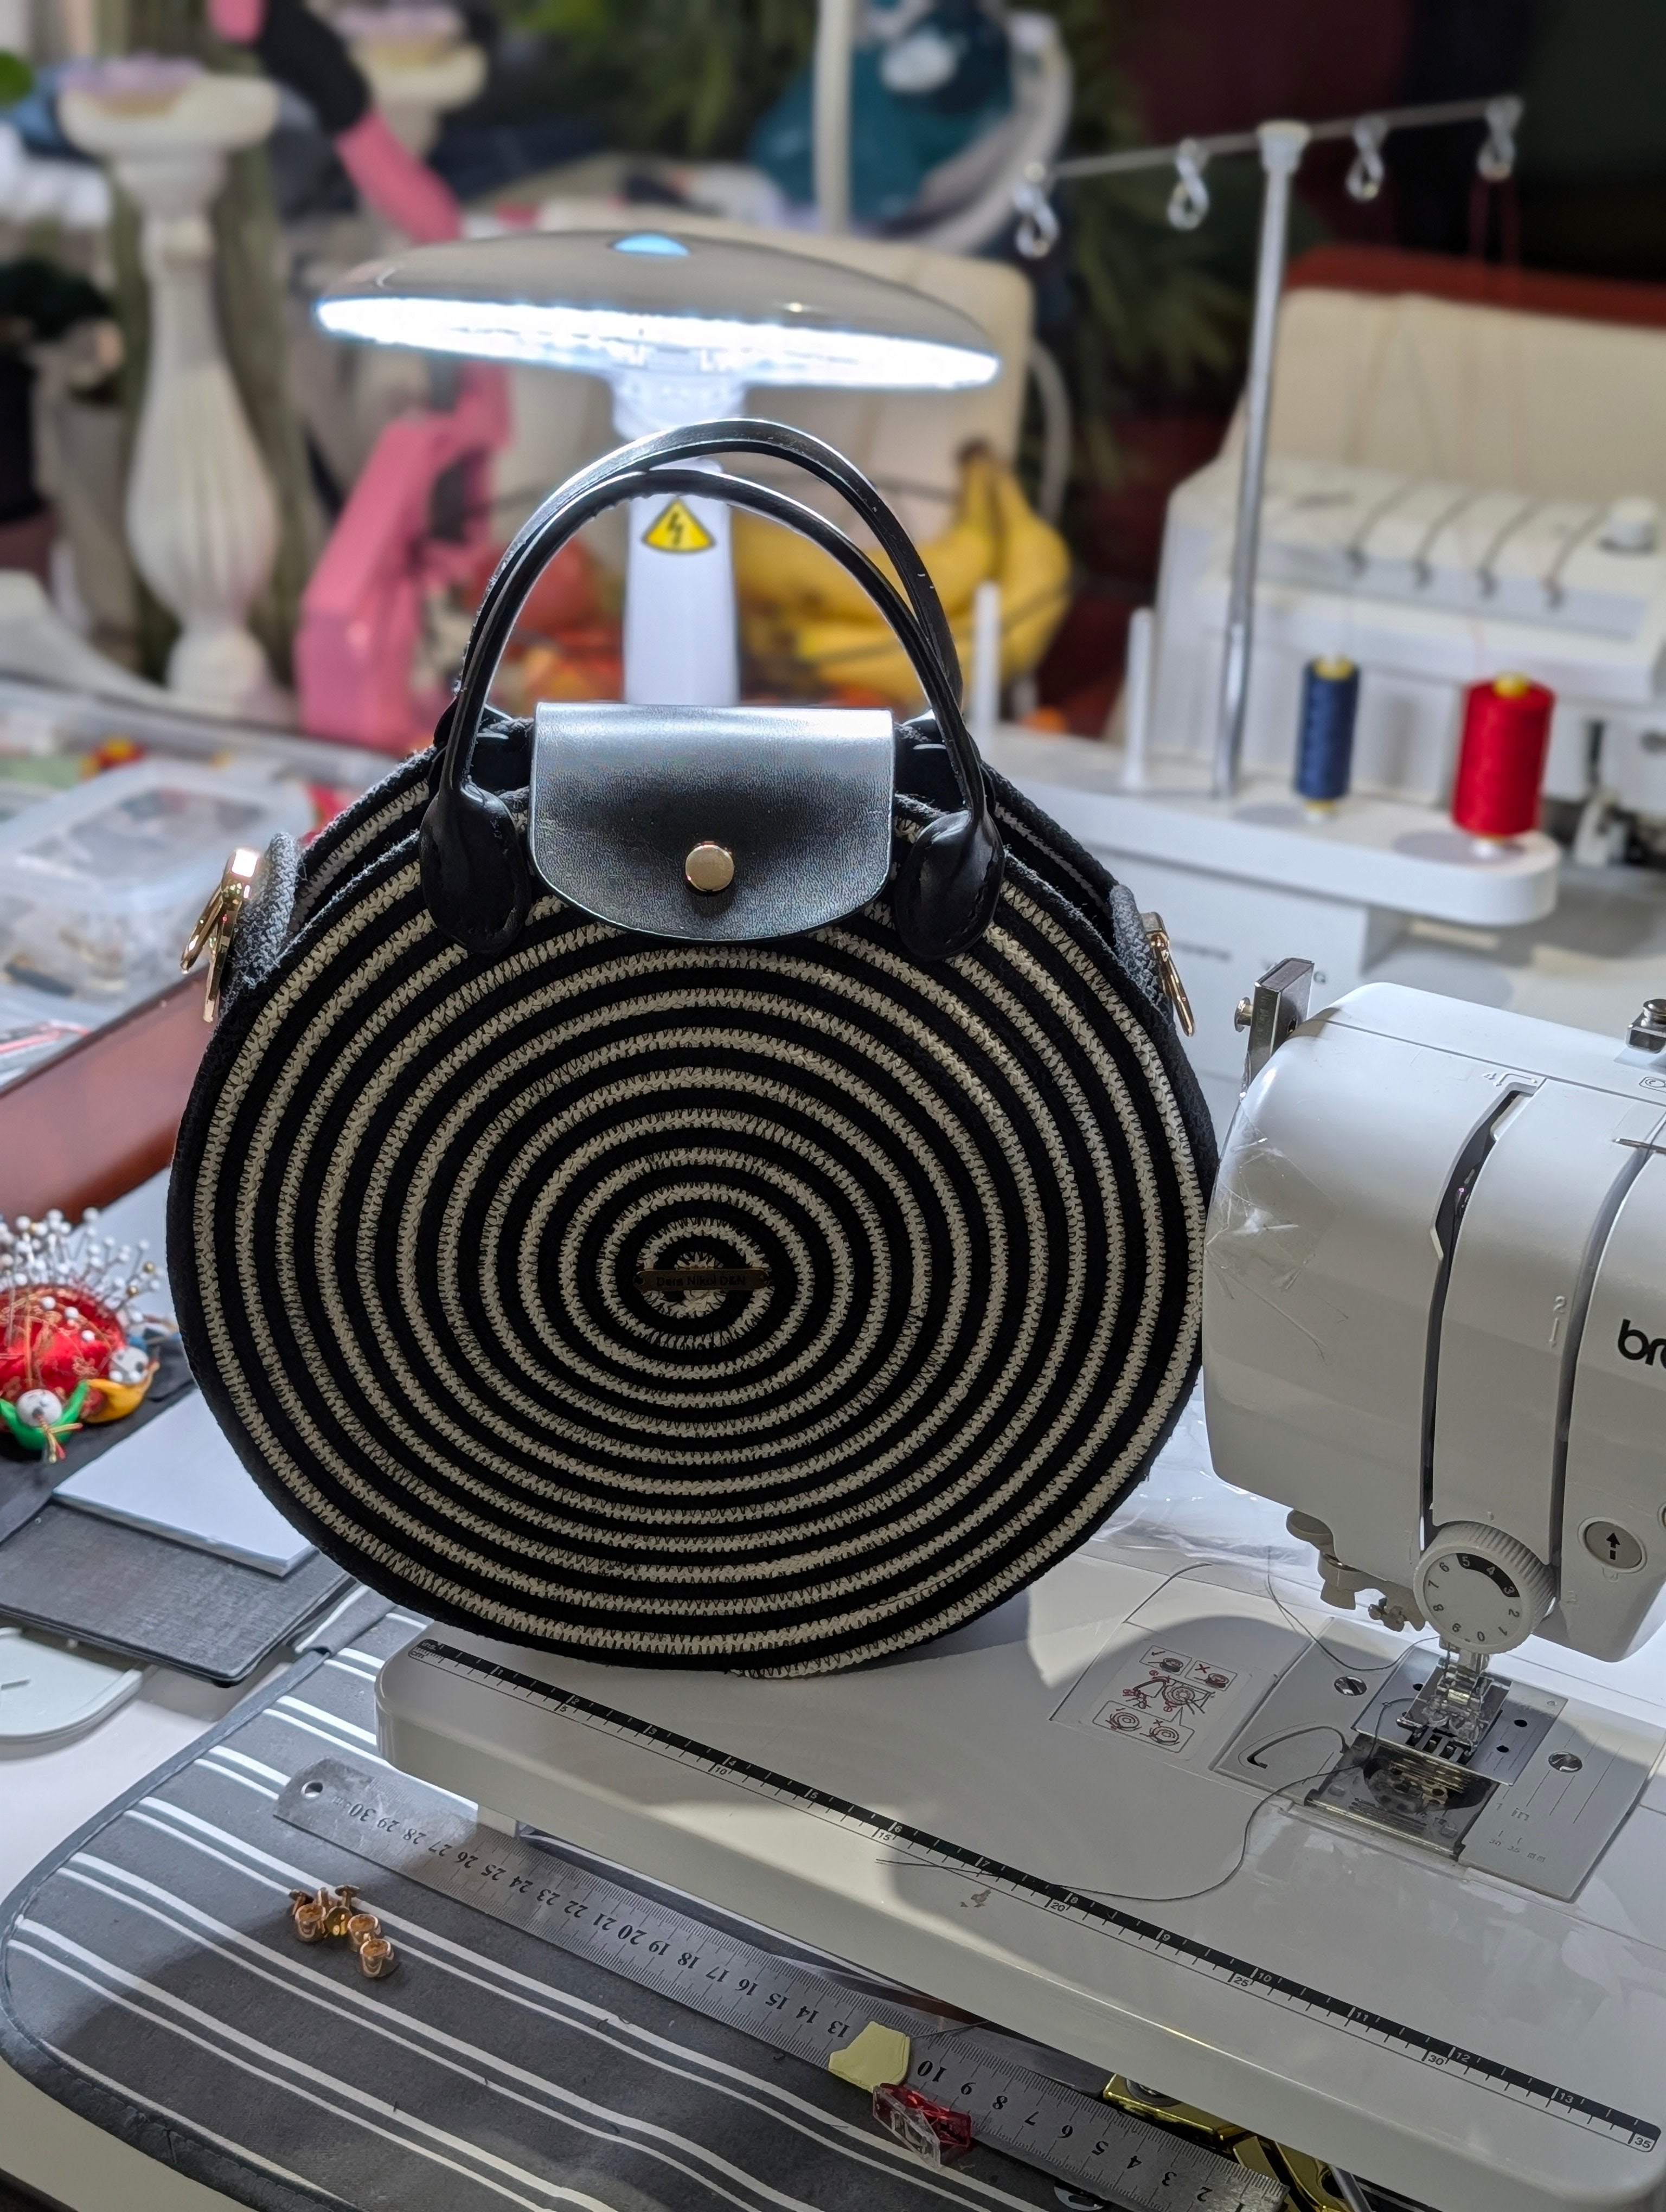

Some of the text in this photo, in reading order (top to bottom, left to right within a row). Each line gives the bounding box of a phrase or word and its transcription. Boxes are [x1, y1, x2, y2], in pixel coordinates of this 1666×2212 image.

[1553, 1295, 1567, 1314] 2
[1618, 1319, 1666, 1369] br
[1428, 1556, 1520, 1642] 6 5 4 3 7 8 2 9 0 1
[350, 1803, 376, 1822] 30
[377, 1816, 401, 1832] 29
[402, 1827, 427, 1845] 28
[428, 1840, 452, 1856] 27
[454, 1851, 479, 1868] 26
[481, 1863, 507, 1881] 25
[509, 1875, 534, 1893] 24
[536, 1888, 563, 1905] 23
[564, 1900, 588, 1918] 22
[593, 1913, 619, 1931] 21
[617, 1924, 648, 1945] 20
[649, 1939, 671, 1956] 19
[810, 1791, 819, 1799] 5
[894, 1825, 903, 1834] 6
[1257, 1973, 1272, 1983] 10
[1355, 2011, 1369, 2021] 11
[1456, 2052, 1471, 2062] 12
[1559, 2092, 1574, 2104] 13
[677, 1952, 701, 1969] 18
[714, 1766, 728, 1776] 10
[877, 1832, 891, 1842] 15
[1050, 1902, 1066, 1912] 20
[1234, 1976, 1250, 1987] 25
[1427, 2054, 1444, 2066] 30
[1634, 2137, 1652, 2149] 35
[705, 1966, 730, 1983] 17
[734, 1978, 759, 1996] 16
[765, 1992, 791, 2010] 15
[796, 2005, 821, 2024] 14
[827, 2020, 850, 2038] 13
[917, 2060, 947, 2083] 10
[960, 2081, 977, 2095] 9
[991, 2095, 1008, 2111] 8
[1025, 2111, 1040, 2126] 7
[1058, 2124, 1074, 2139] 6
[1091, 2140, 1109, 2156] 5
[1126, 2155, 1142, 2170] 4
[1161, 2171, 1177, 2186] 3
[1196, 2186, 1213, 2202] 2
